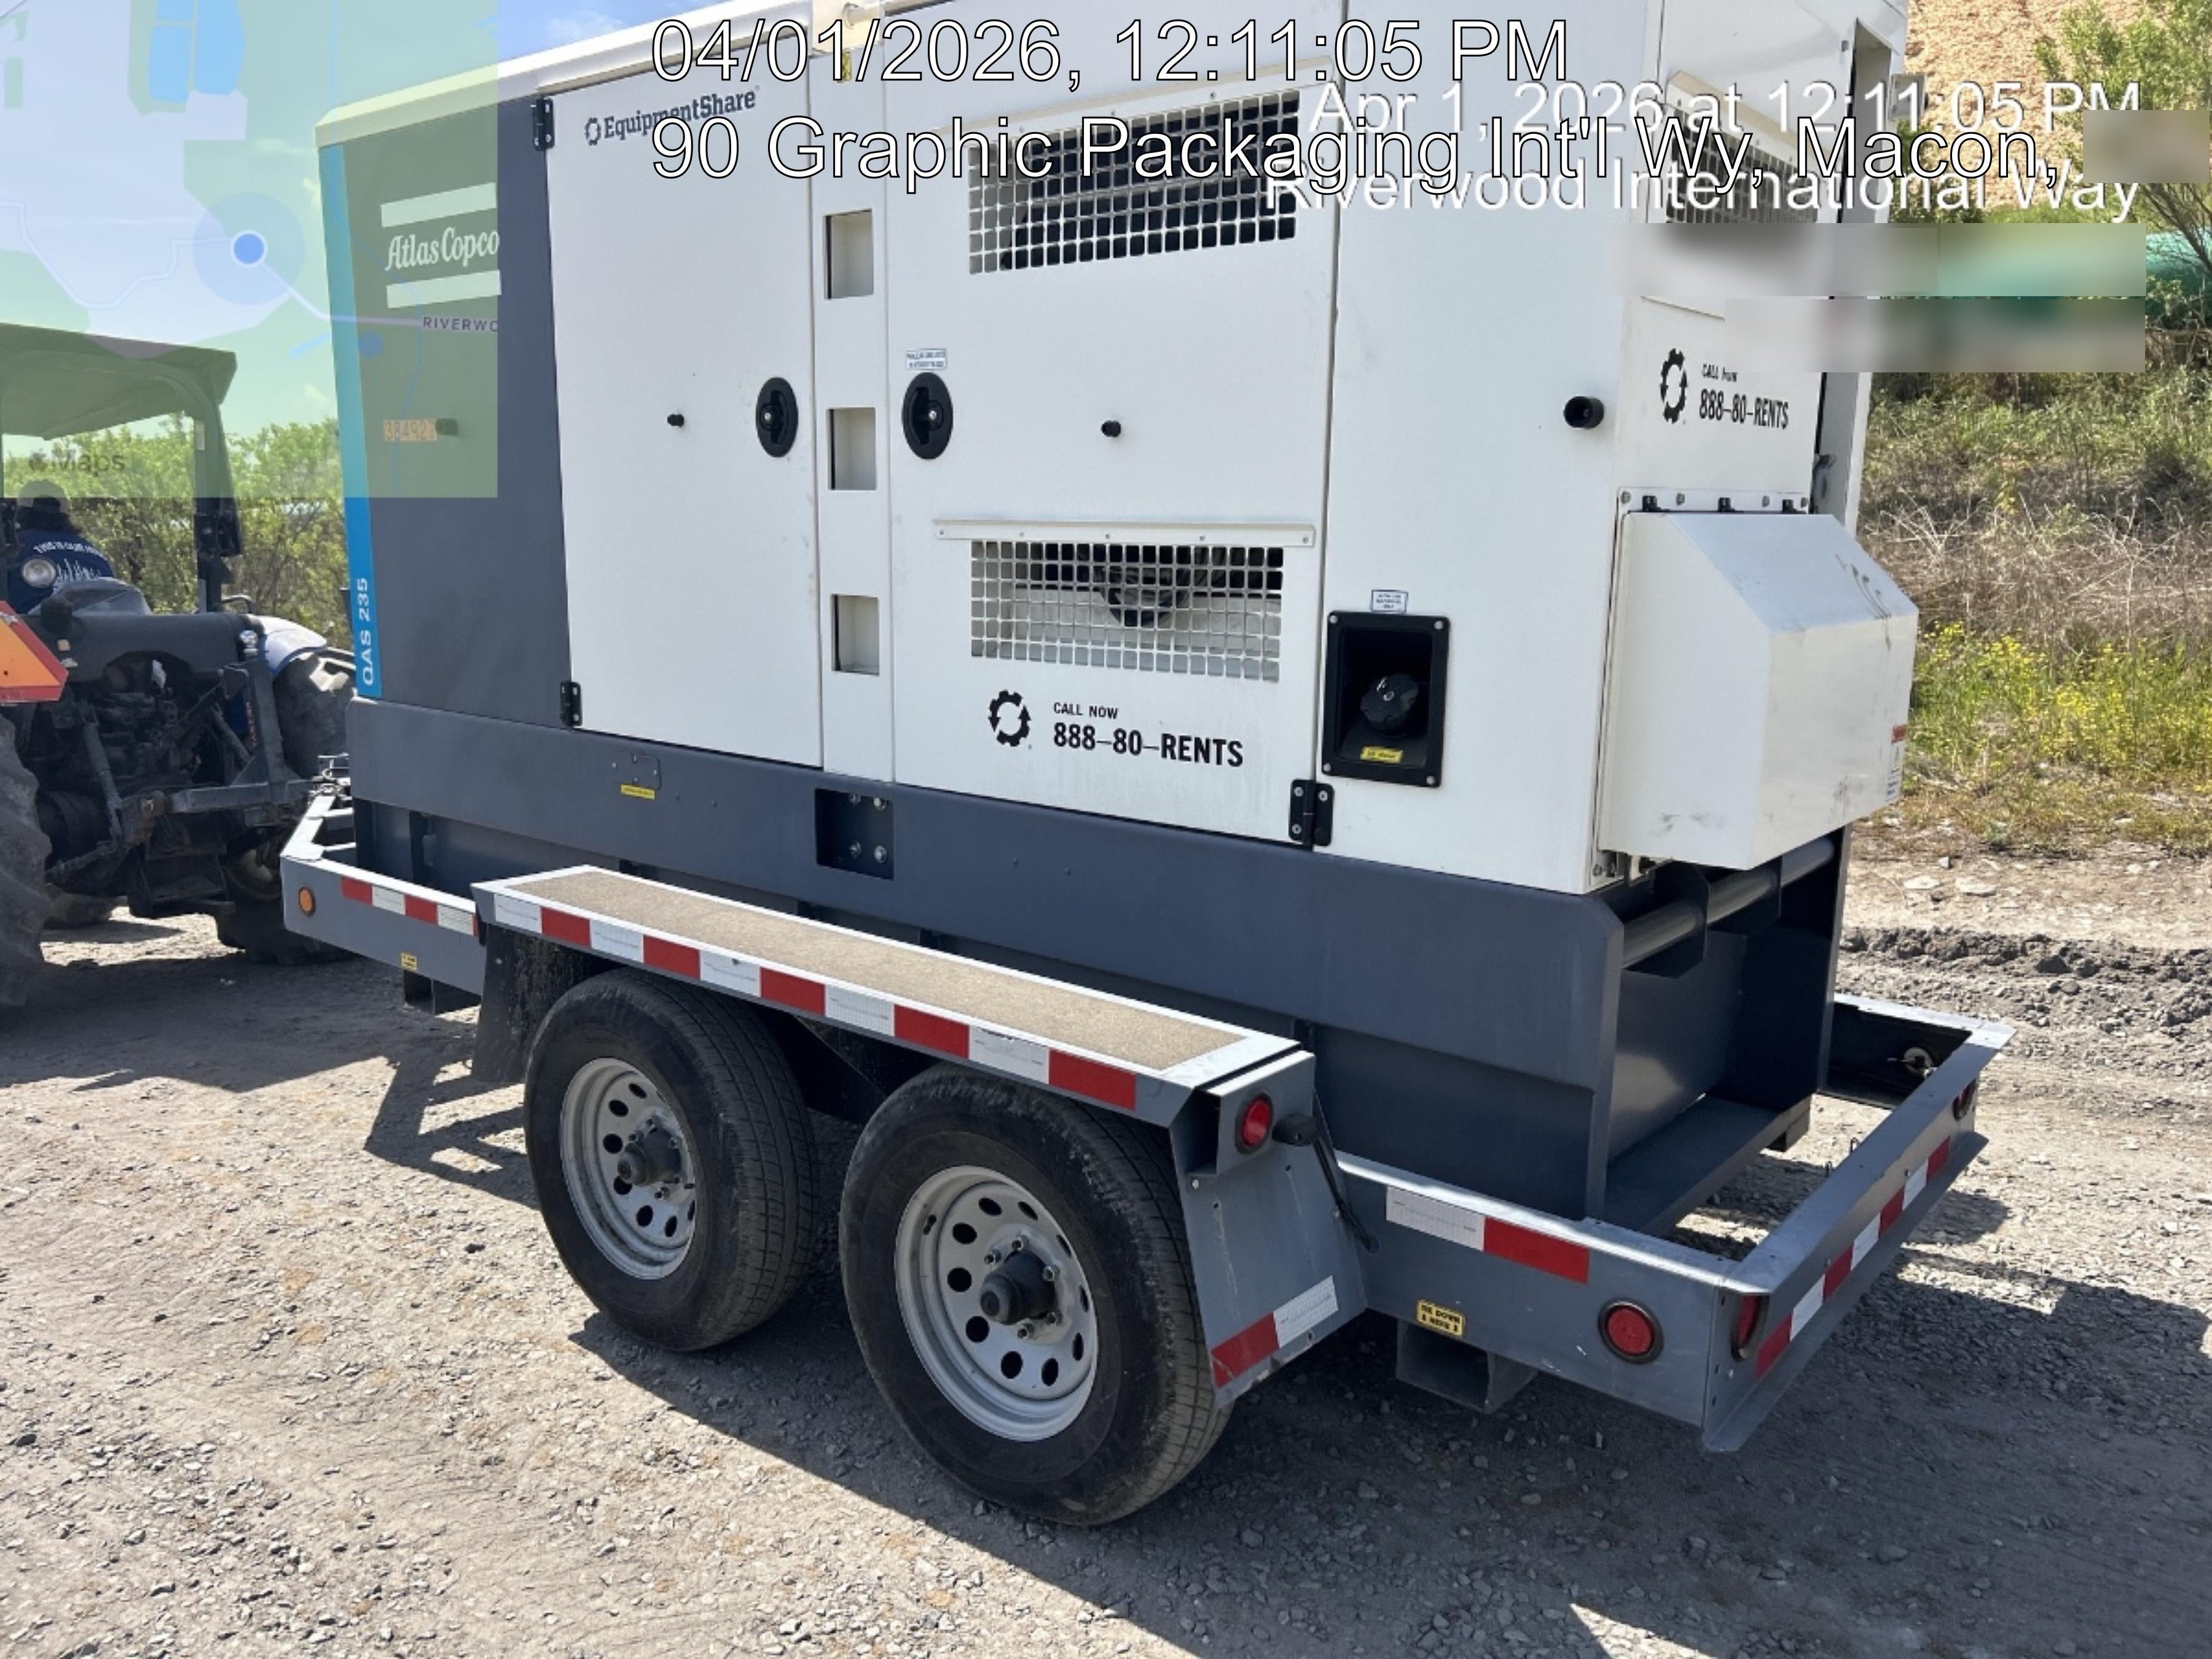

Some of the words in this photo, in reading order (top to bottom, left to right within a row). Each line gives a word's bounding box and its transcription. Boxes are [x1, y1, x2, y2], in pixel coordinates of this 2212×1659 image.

[604, 90, 756, 141] EquipmentShare
[385, 234, 439, 271] Atlas
[441, 226, 500, 267] Copco
[1700, 388, 1789, 429] 888-80-RENTS
[356, 578, 371, 622] 235
[360, 629, 374, 686] QAS
[1054, 702, 1083, 716] CALL
[1089, 705, 1118, 720] NOW
[1053, 722, 1244, 767] 888-80-RENTS
